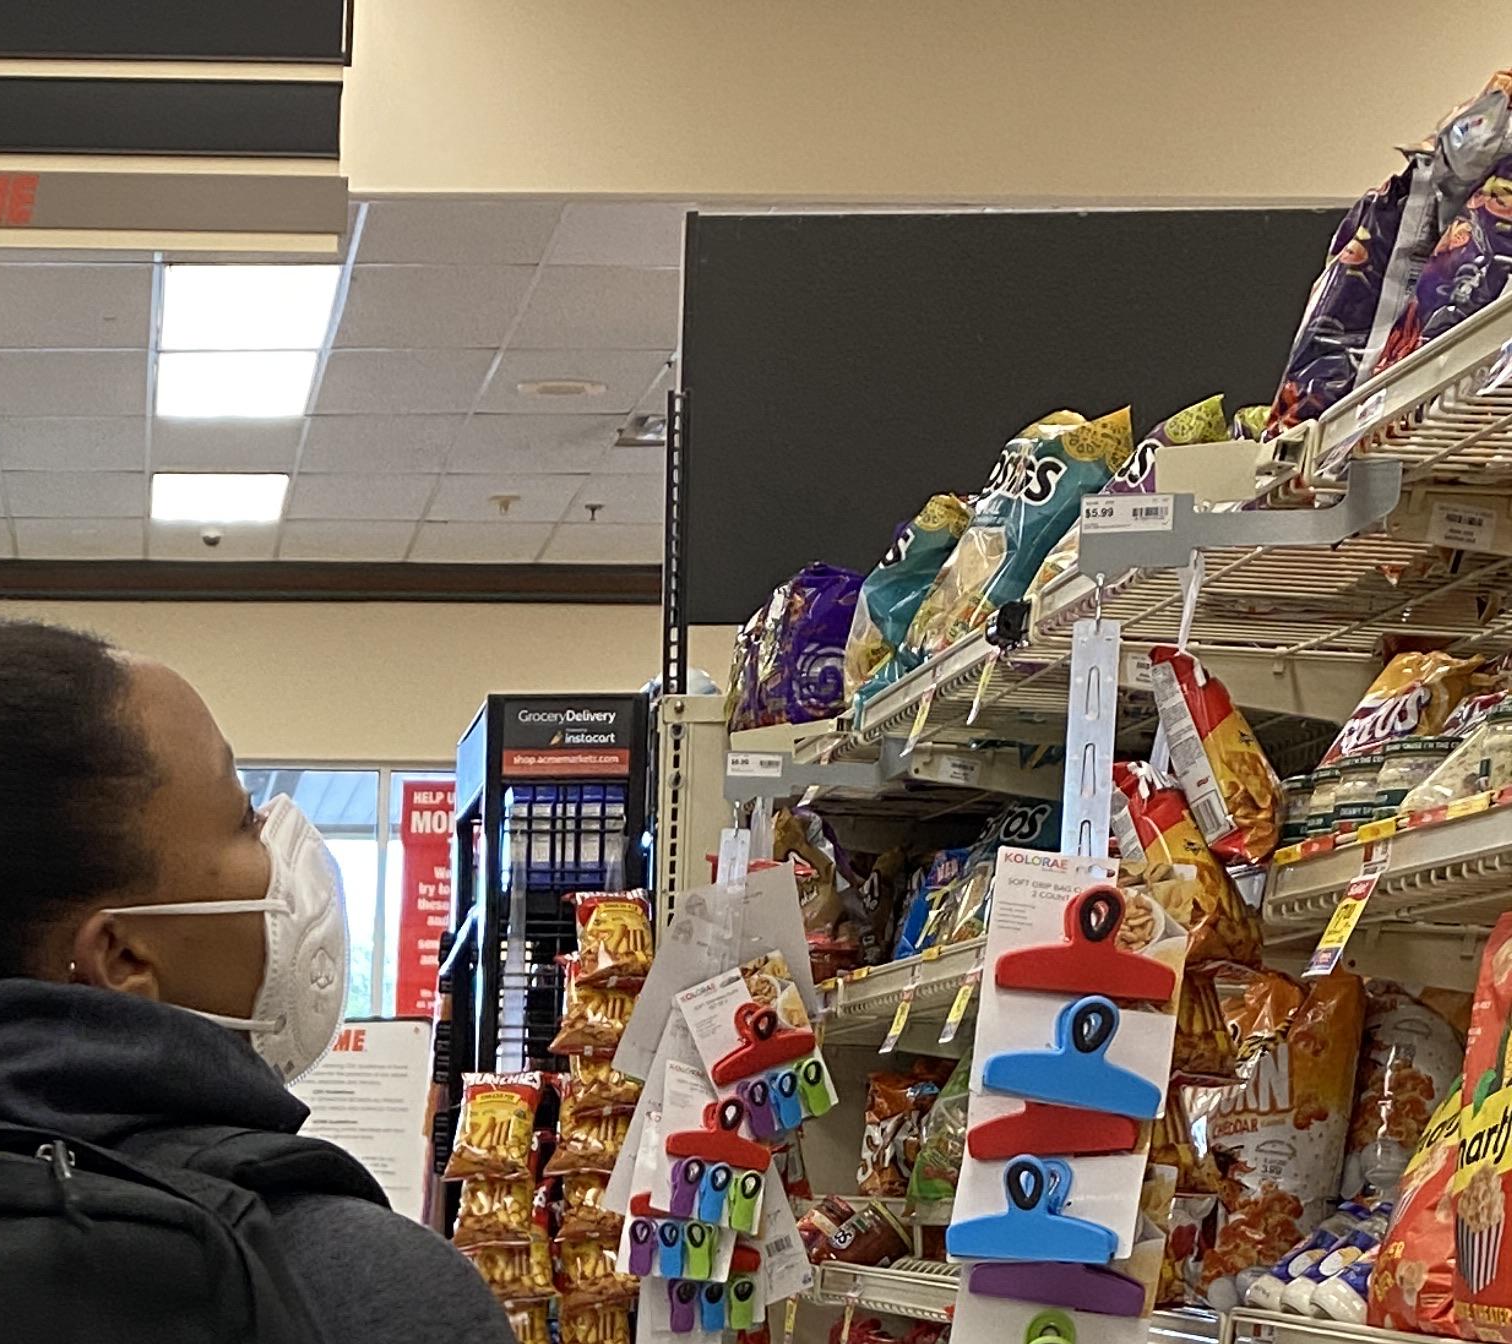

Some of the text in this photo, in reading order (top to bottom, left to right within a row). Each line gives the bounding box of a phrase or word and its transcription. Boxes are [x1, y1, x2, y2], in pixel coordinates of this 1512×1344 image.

[413, 791, 444, 805] HELP
[1004, 852, 1069, 870] KOLORAE
[333, 1028, 367, 1052] ME
